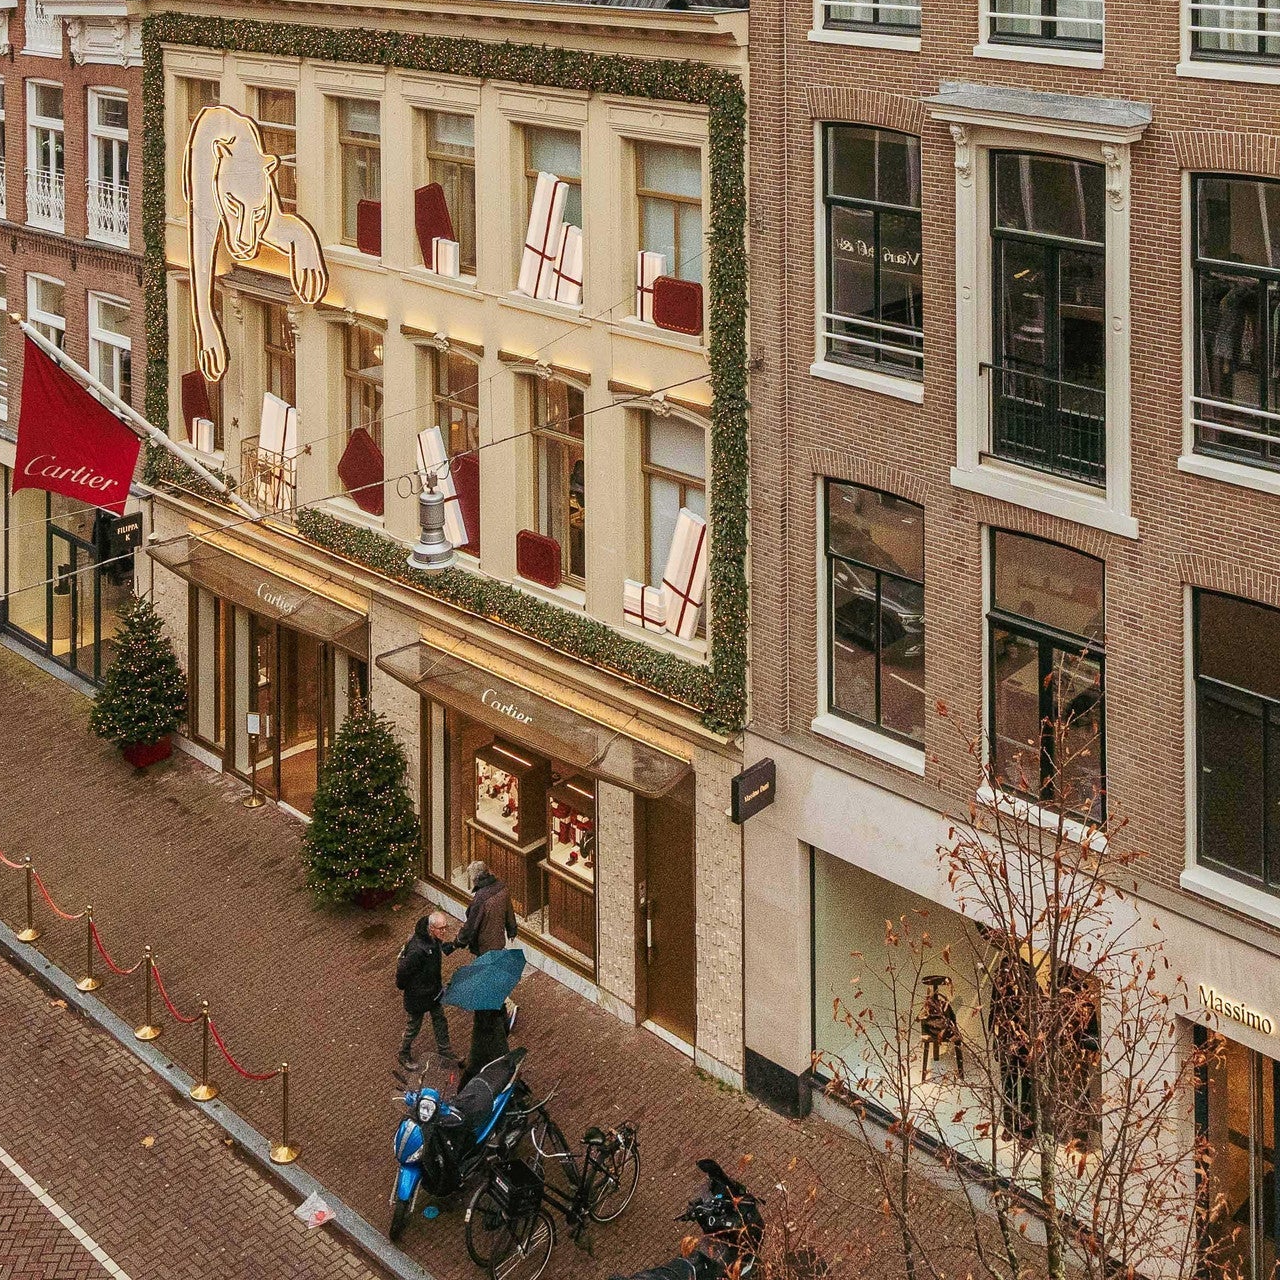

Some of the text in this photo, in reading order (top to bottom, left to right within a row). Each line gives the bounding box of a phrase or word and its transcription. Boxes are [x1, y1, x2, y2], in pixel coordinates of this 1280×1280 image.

[24, 454, 118, 491] Cartier
[117, 523, 139, 534] FILIPPA
[257, 582, 297, 613] Cartier
[481, 688, 533, 724] Cartier
[1198, 984, 1272, 1035] Massimo
